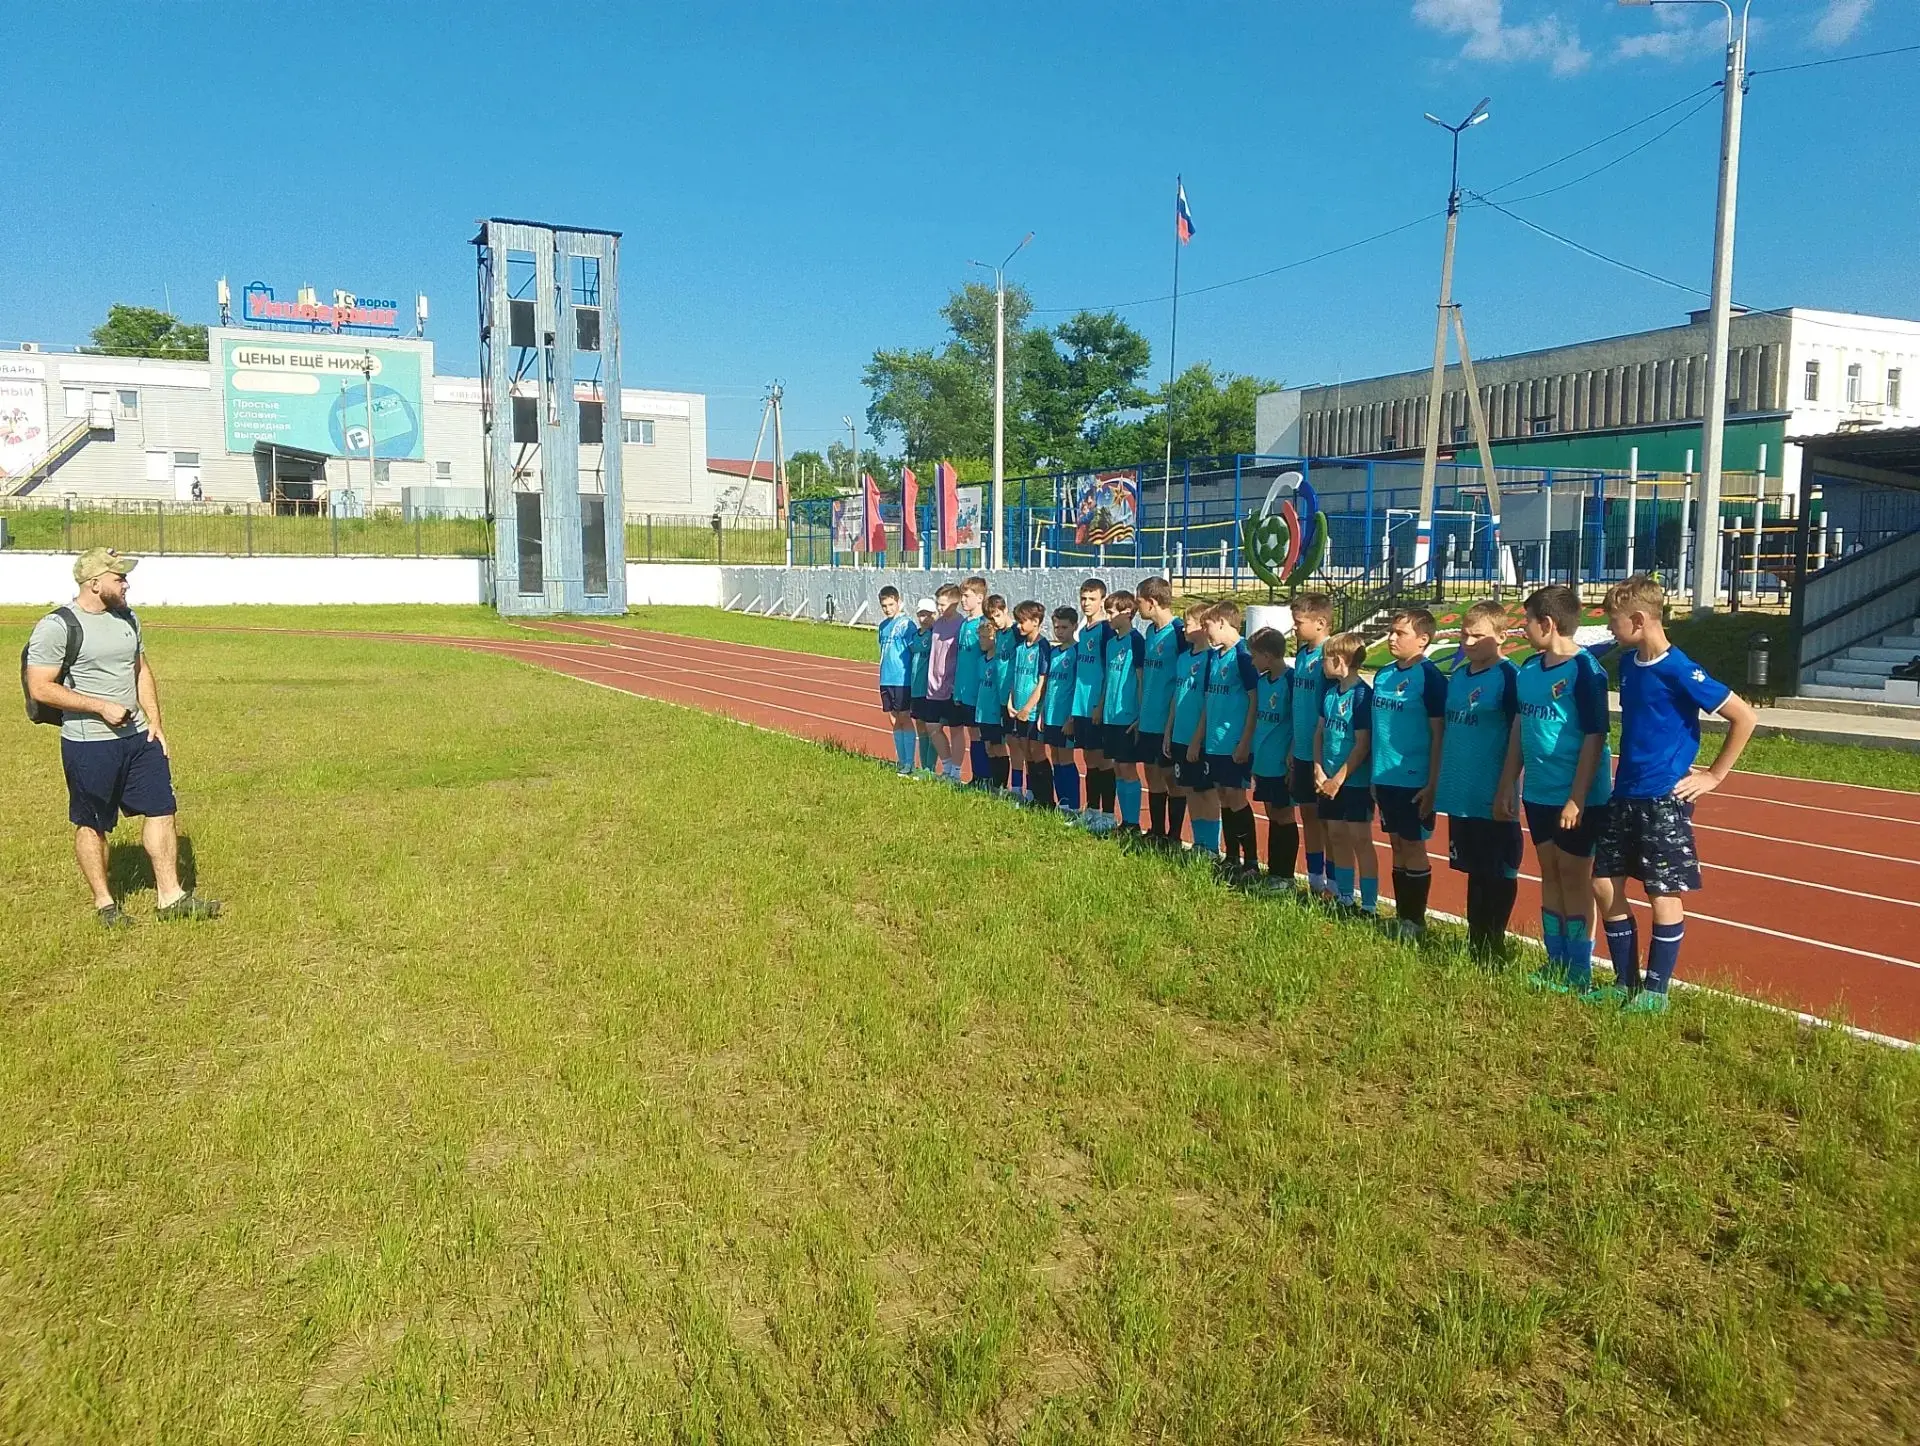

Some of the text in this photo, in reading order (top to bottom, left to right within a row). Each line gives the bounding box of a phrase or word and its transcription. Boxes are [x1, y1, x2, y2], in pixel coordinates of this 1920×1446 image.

[344, 293, 398, 309] Суворов
[238, 350, 375, 373] ЦЕНЫ ЕЩЁ НИЖЕ
[0, 364, 35, 375] ВАРЫ
[232, 398, 281, 411] Простые
[233, 410, 277, 420] условия
[233, 421, 291, 432] очевидная
[233, 431, 277, 442] выгода!
[1174, 762, 1181, 779] 8
